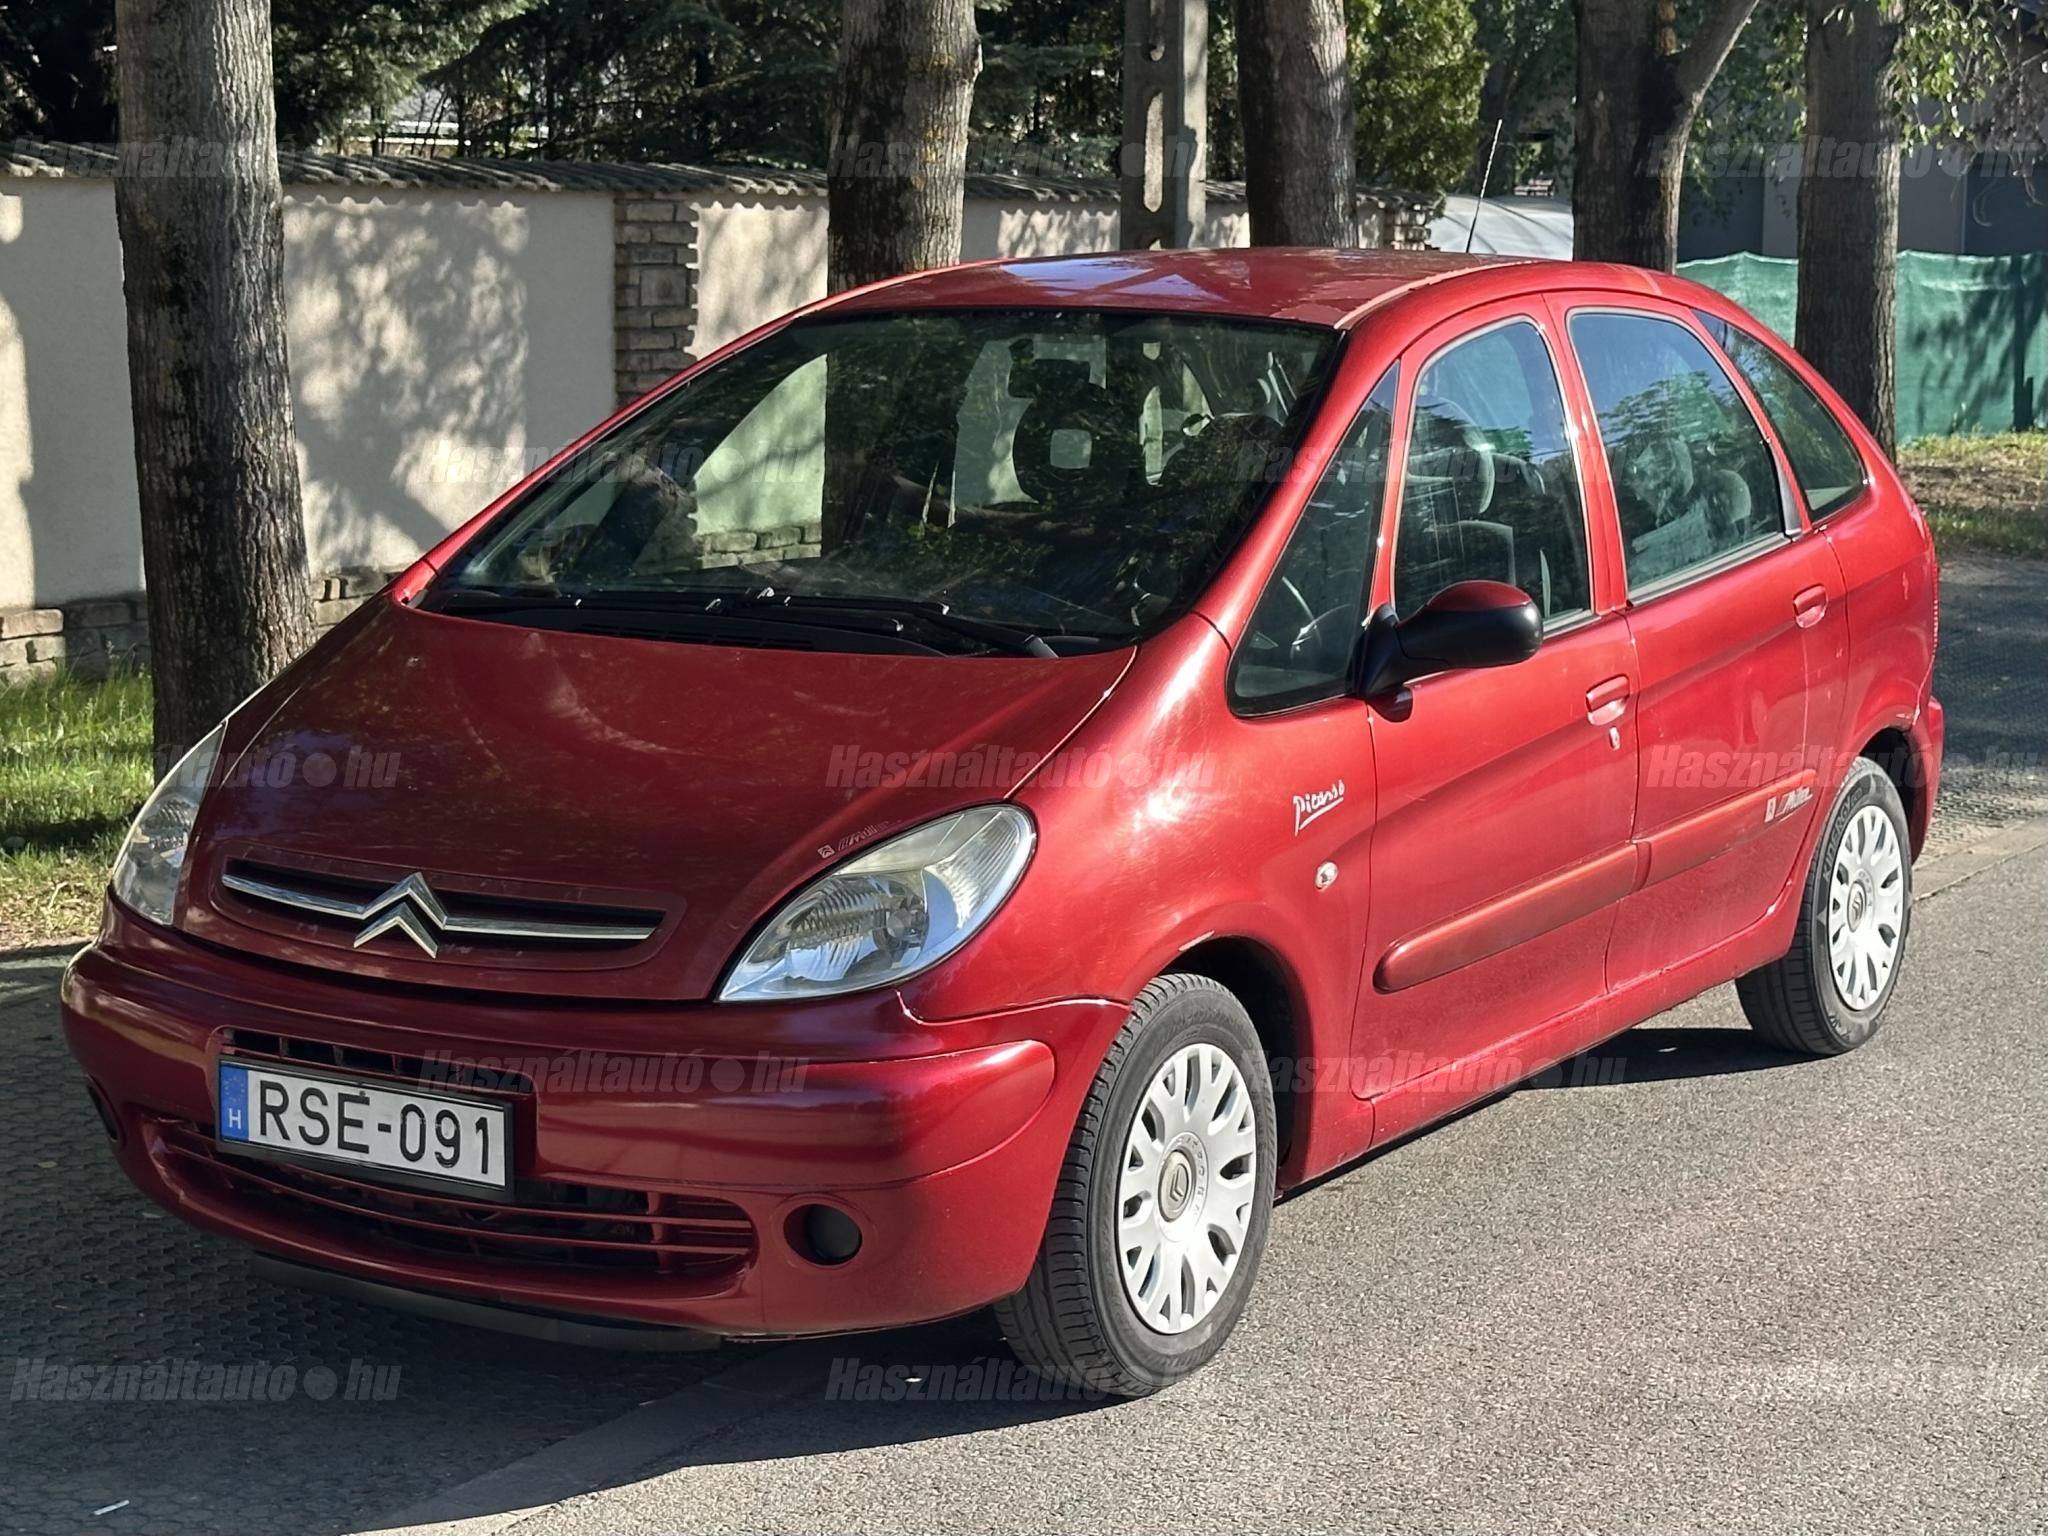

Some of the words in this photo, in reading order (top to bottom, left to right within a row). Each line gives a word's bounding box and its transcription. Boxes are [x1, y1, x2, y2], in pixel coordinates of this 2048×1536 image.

[1293, 779, 1345, 837] Picasso
[229, 1108, 241, 1129] H
[260, 1080, 489, 1175] RSE-091
